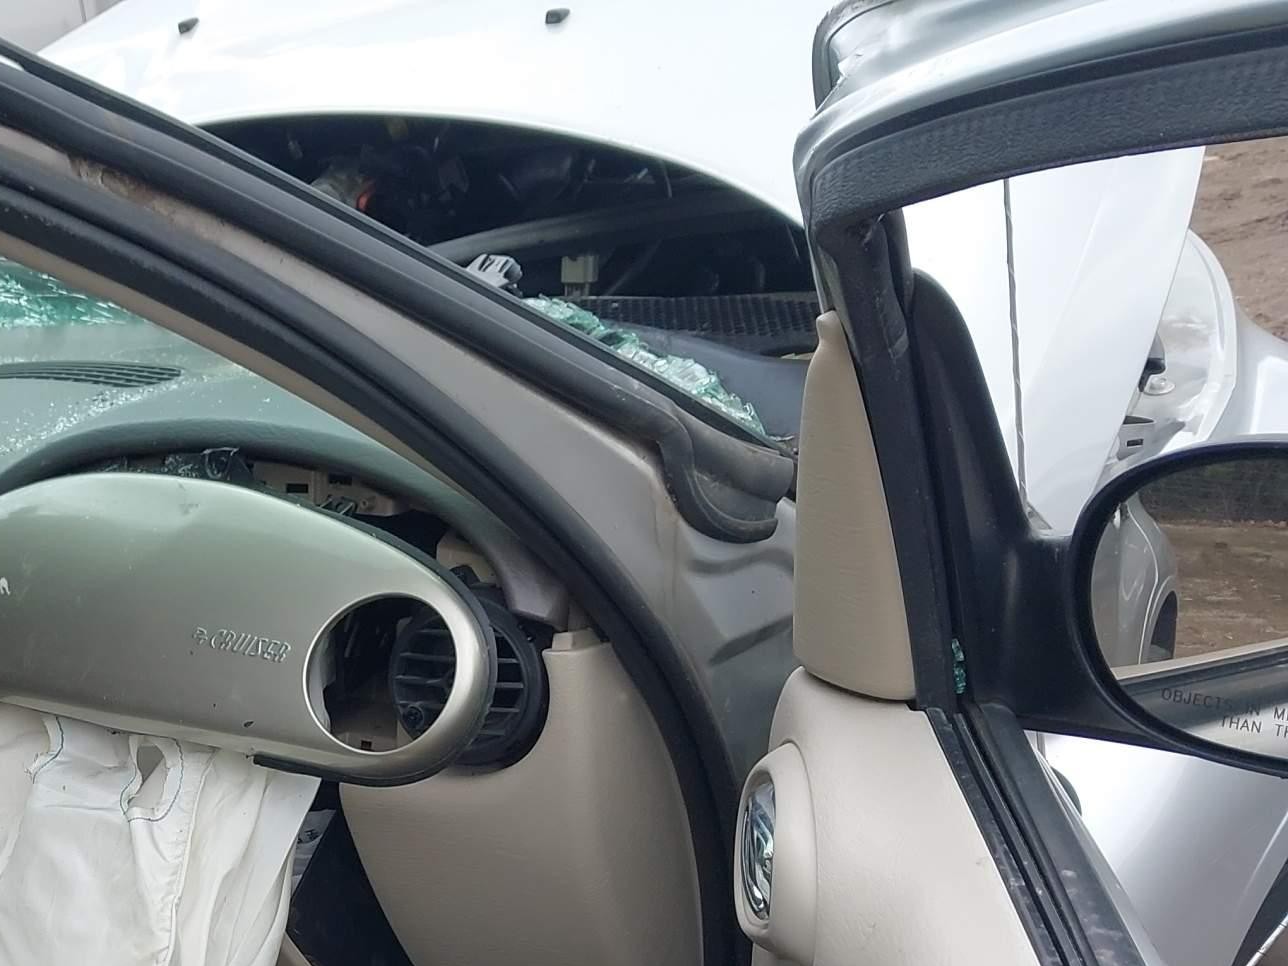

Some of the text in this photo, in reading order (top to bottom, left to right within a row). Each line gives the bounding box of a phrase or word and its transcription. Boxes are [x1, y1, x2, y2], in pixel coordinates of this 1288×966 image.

[211, 628, 291, 663] CRUISER
[1161, 687, 1233, 709] OBJECTS
[1273, 705, 1288, 721] M
[1222, 714, 1262, 733] THAN
